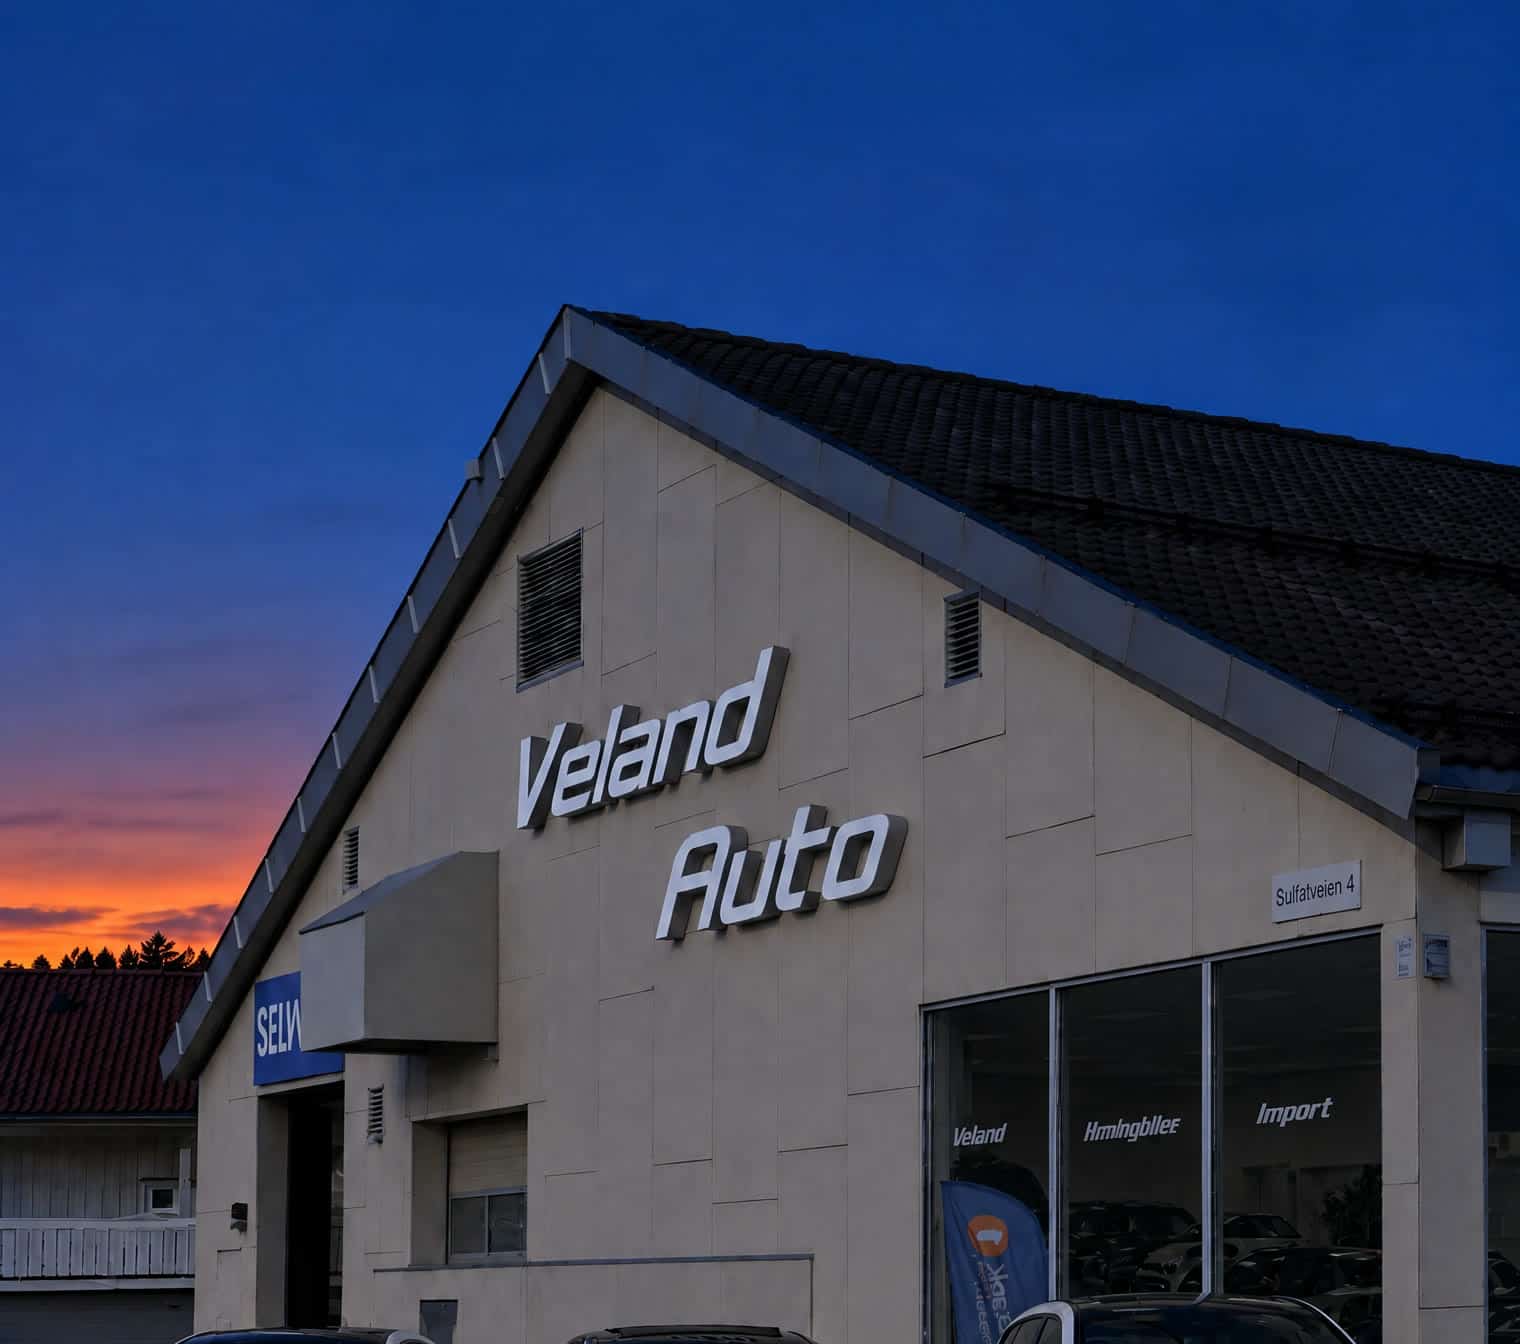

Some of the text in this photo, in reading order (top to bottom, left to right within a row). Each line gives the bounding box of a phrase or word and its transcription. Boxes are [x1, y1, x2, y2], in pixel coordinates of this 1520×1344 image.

[517, 645, 790, 830] Veland
[655, 804, 908, 940] Auto
[1276, 873, 1355, 907] Sulfatveien 4
[1256, 1097, 1334, 1128] Import
[953, 1122, 1008, 1147] Veland
